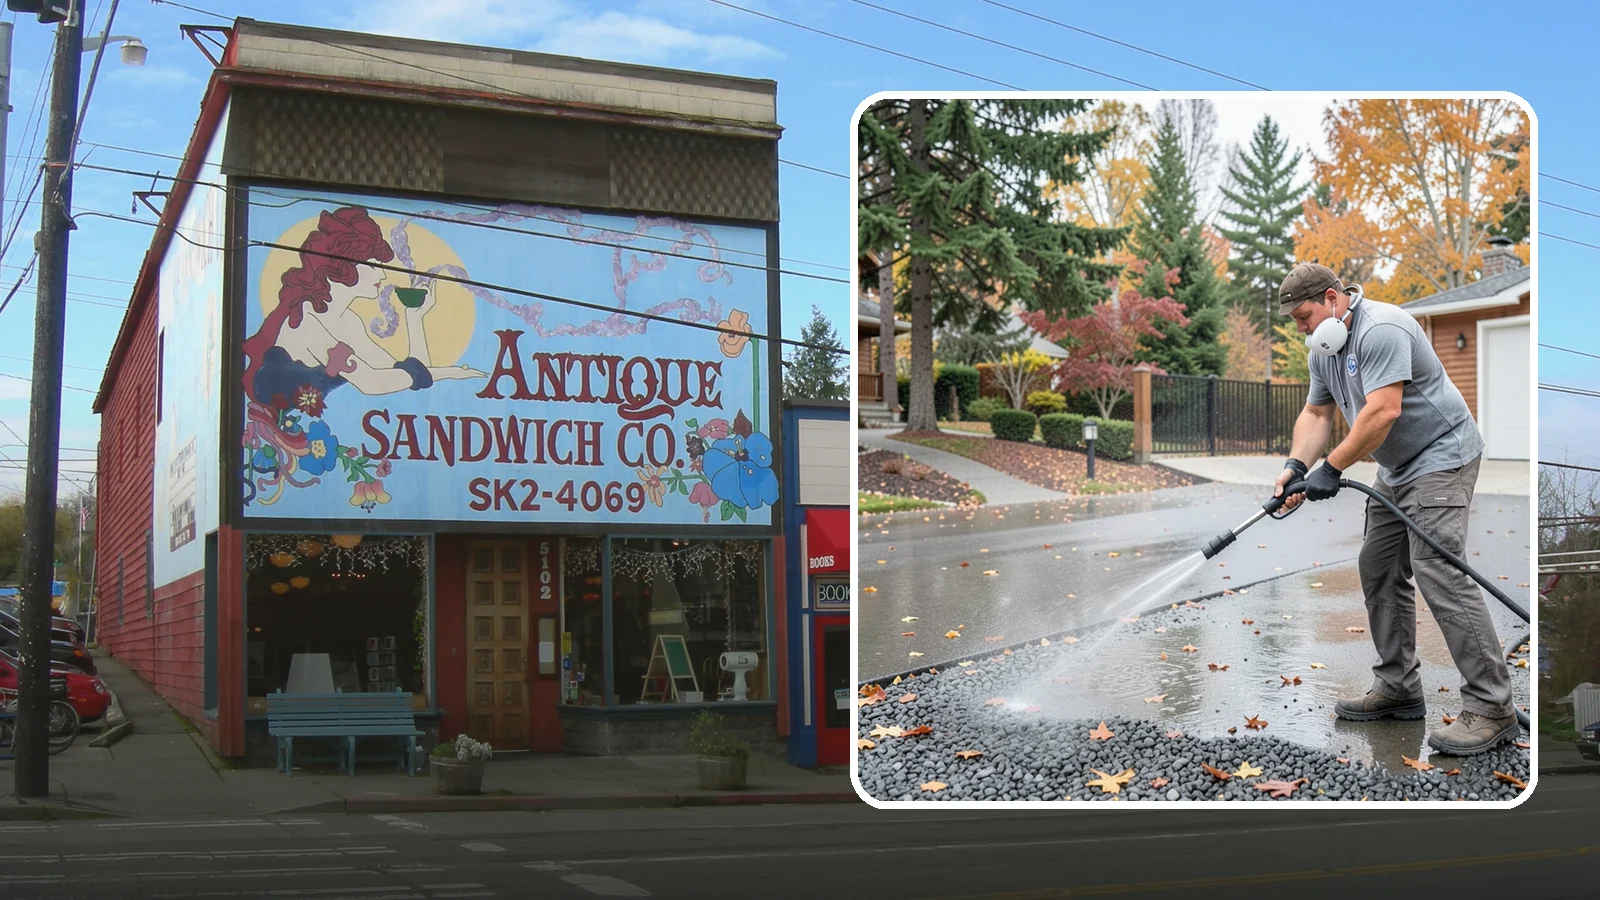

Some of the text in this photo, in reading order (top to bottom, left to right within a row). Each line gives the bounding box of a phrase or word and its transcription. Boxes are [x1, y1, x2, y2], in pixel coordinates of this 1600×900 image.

[477, 329, 724, 420] ANTIQUE
[361, 408, 685, 467] SANDWICH CO.
[468, 477, 646, 513] SK2-4069
[540, 542, 551, 599] 5102
[810, 555, 834, 568] BOOKS
